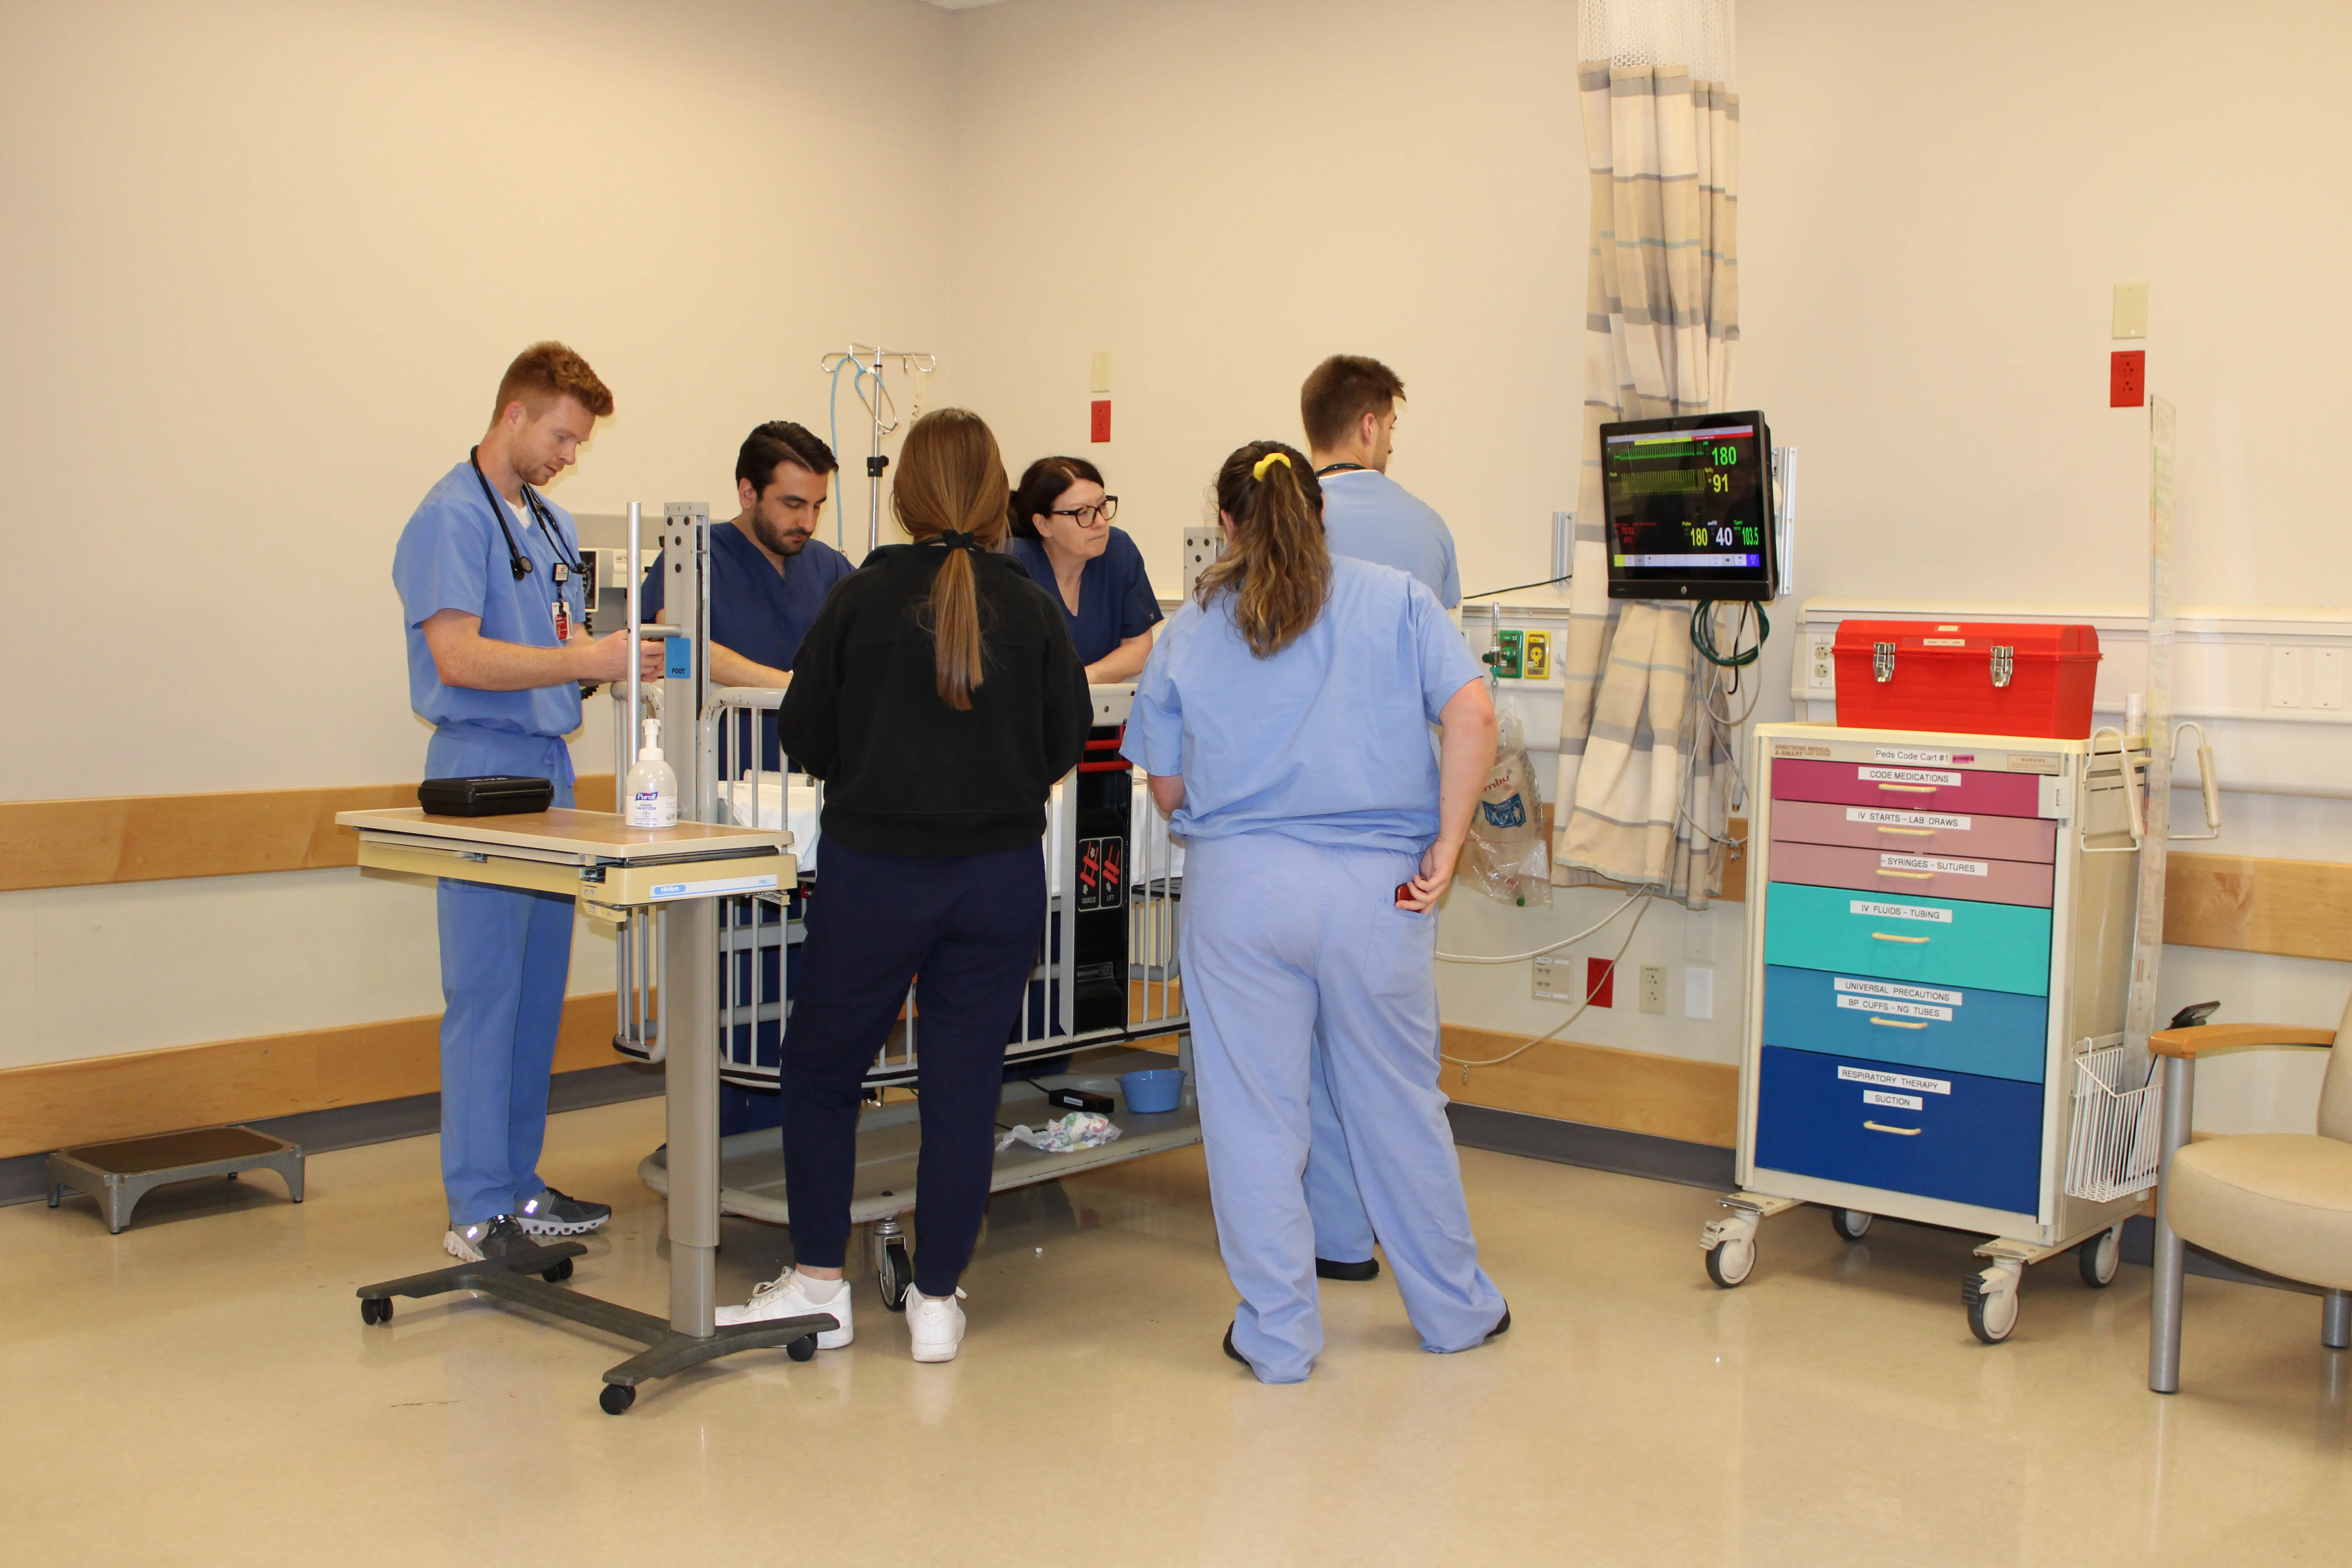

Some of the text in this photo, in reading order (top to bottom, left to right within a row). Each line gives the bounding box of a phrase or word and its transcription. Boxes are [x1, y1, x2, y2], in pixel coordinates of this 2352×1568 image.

[1712, 446, 1737, 466] 180
[1713, 474, 1728, 493] 91
[1690, 528, 1708, 546] 180
[1716, 527, 1733, 546] 40
[1742, 526, 1759, 546] 103.5
[1876, 750, 1895, 758] Peds
[1897, 751, 1918, 760] Code
[1920, 753, 1937, 761] Cart
[1482, 775, 1509, 792] mbu
[1870, 770, 1949, 783] CODE MEDICATIONS
[1870, 812, 1901, 822] STARTS
[1929, 817, 1958, 826] DRAWS
[1887, 857, 1928, 868] SYRINGES
[1937, 862, 1975, 872] SUTURES
[1873, 906, 1901, 915] FLUIDS
[1910, 909, 1940, 919] TUBING
[1100, 964, 1112, 976] 500
[1846, 982, 1950, 1001] UNIVERSAL PRECAUTIONS
[1863, 1001, 1889, 1010] CUFFS
[1914, 1007, 1940, 1017] TUBES
[1842, 1070, 1938, 1090] RESPIRATORY THERAPY
[1875, 1095, 1910, 1106] SUCTION
